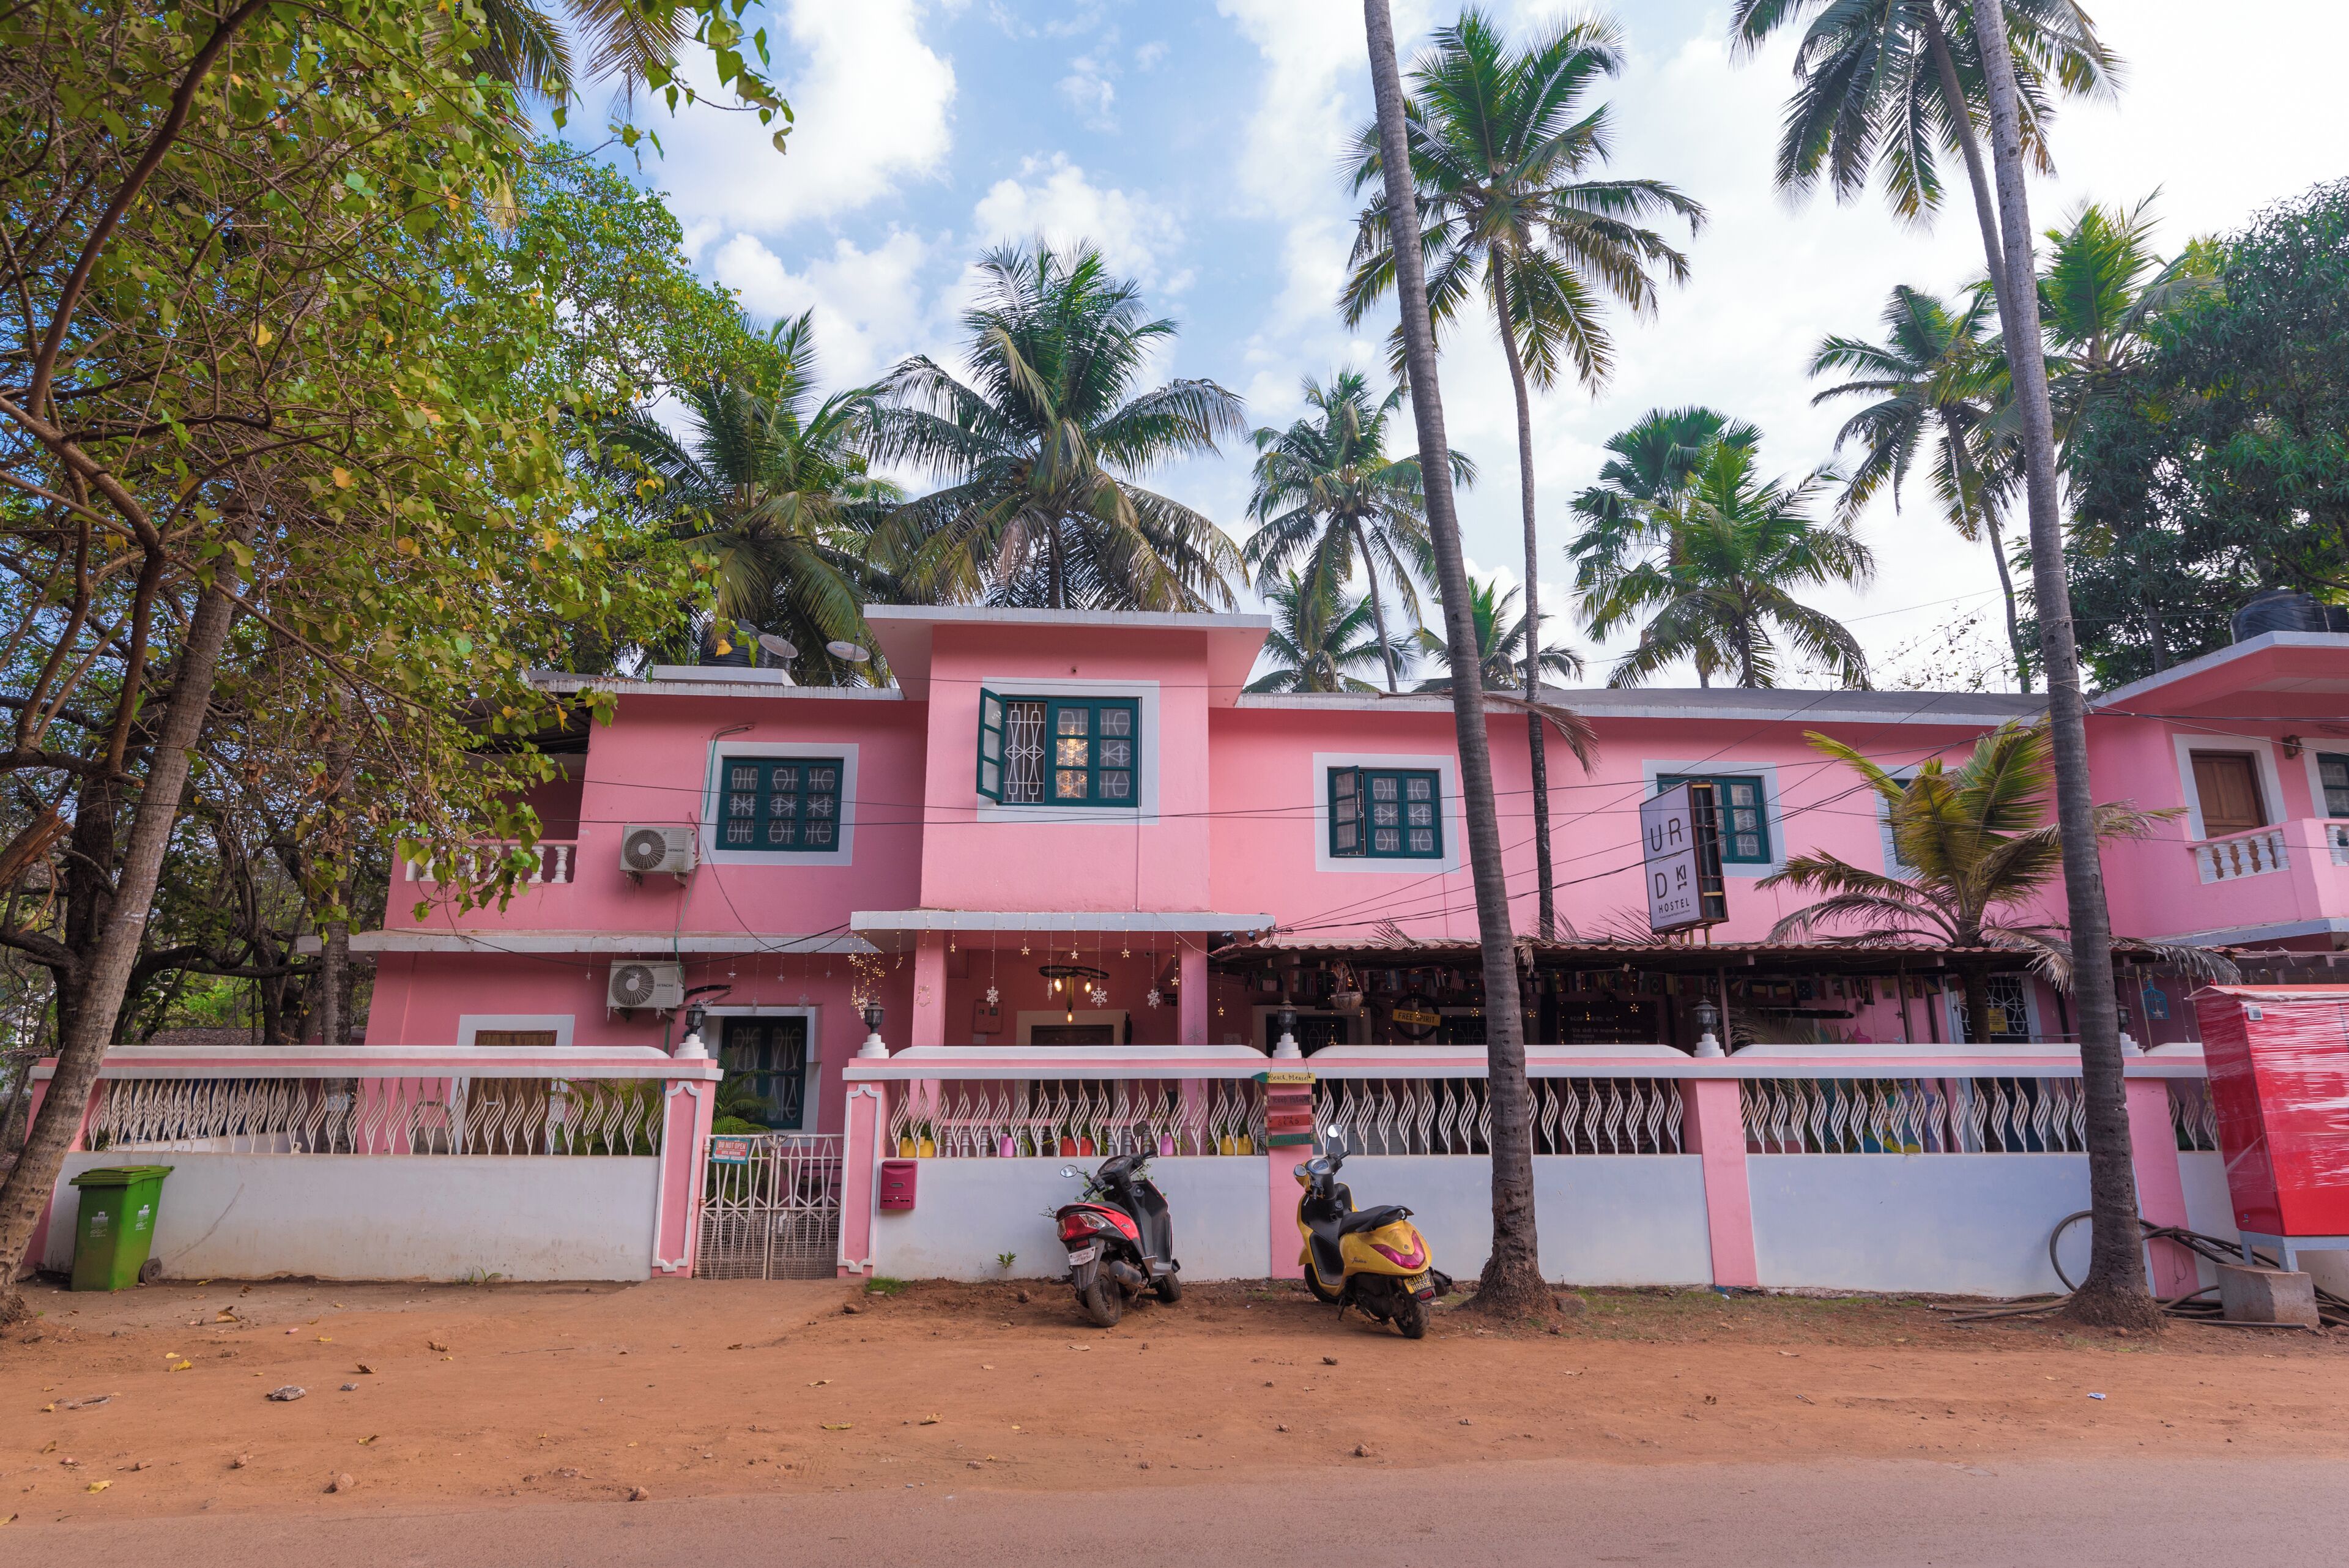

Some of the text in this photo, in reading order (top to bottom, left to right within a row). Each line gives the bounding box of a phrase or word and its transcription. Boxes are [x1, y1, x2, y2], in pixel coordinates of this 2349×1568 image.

[1659, 897, 1690, 913] HOSTEL
[1398, 1012, 1435, 1024] FREE SPIRIT
